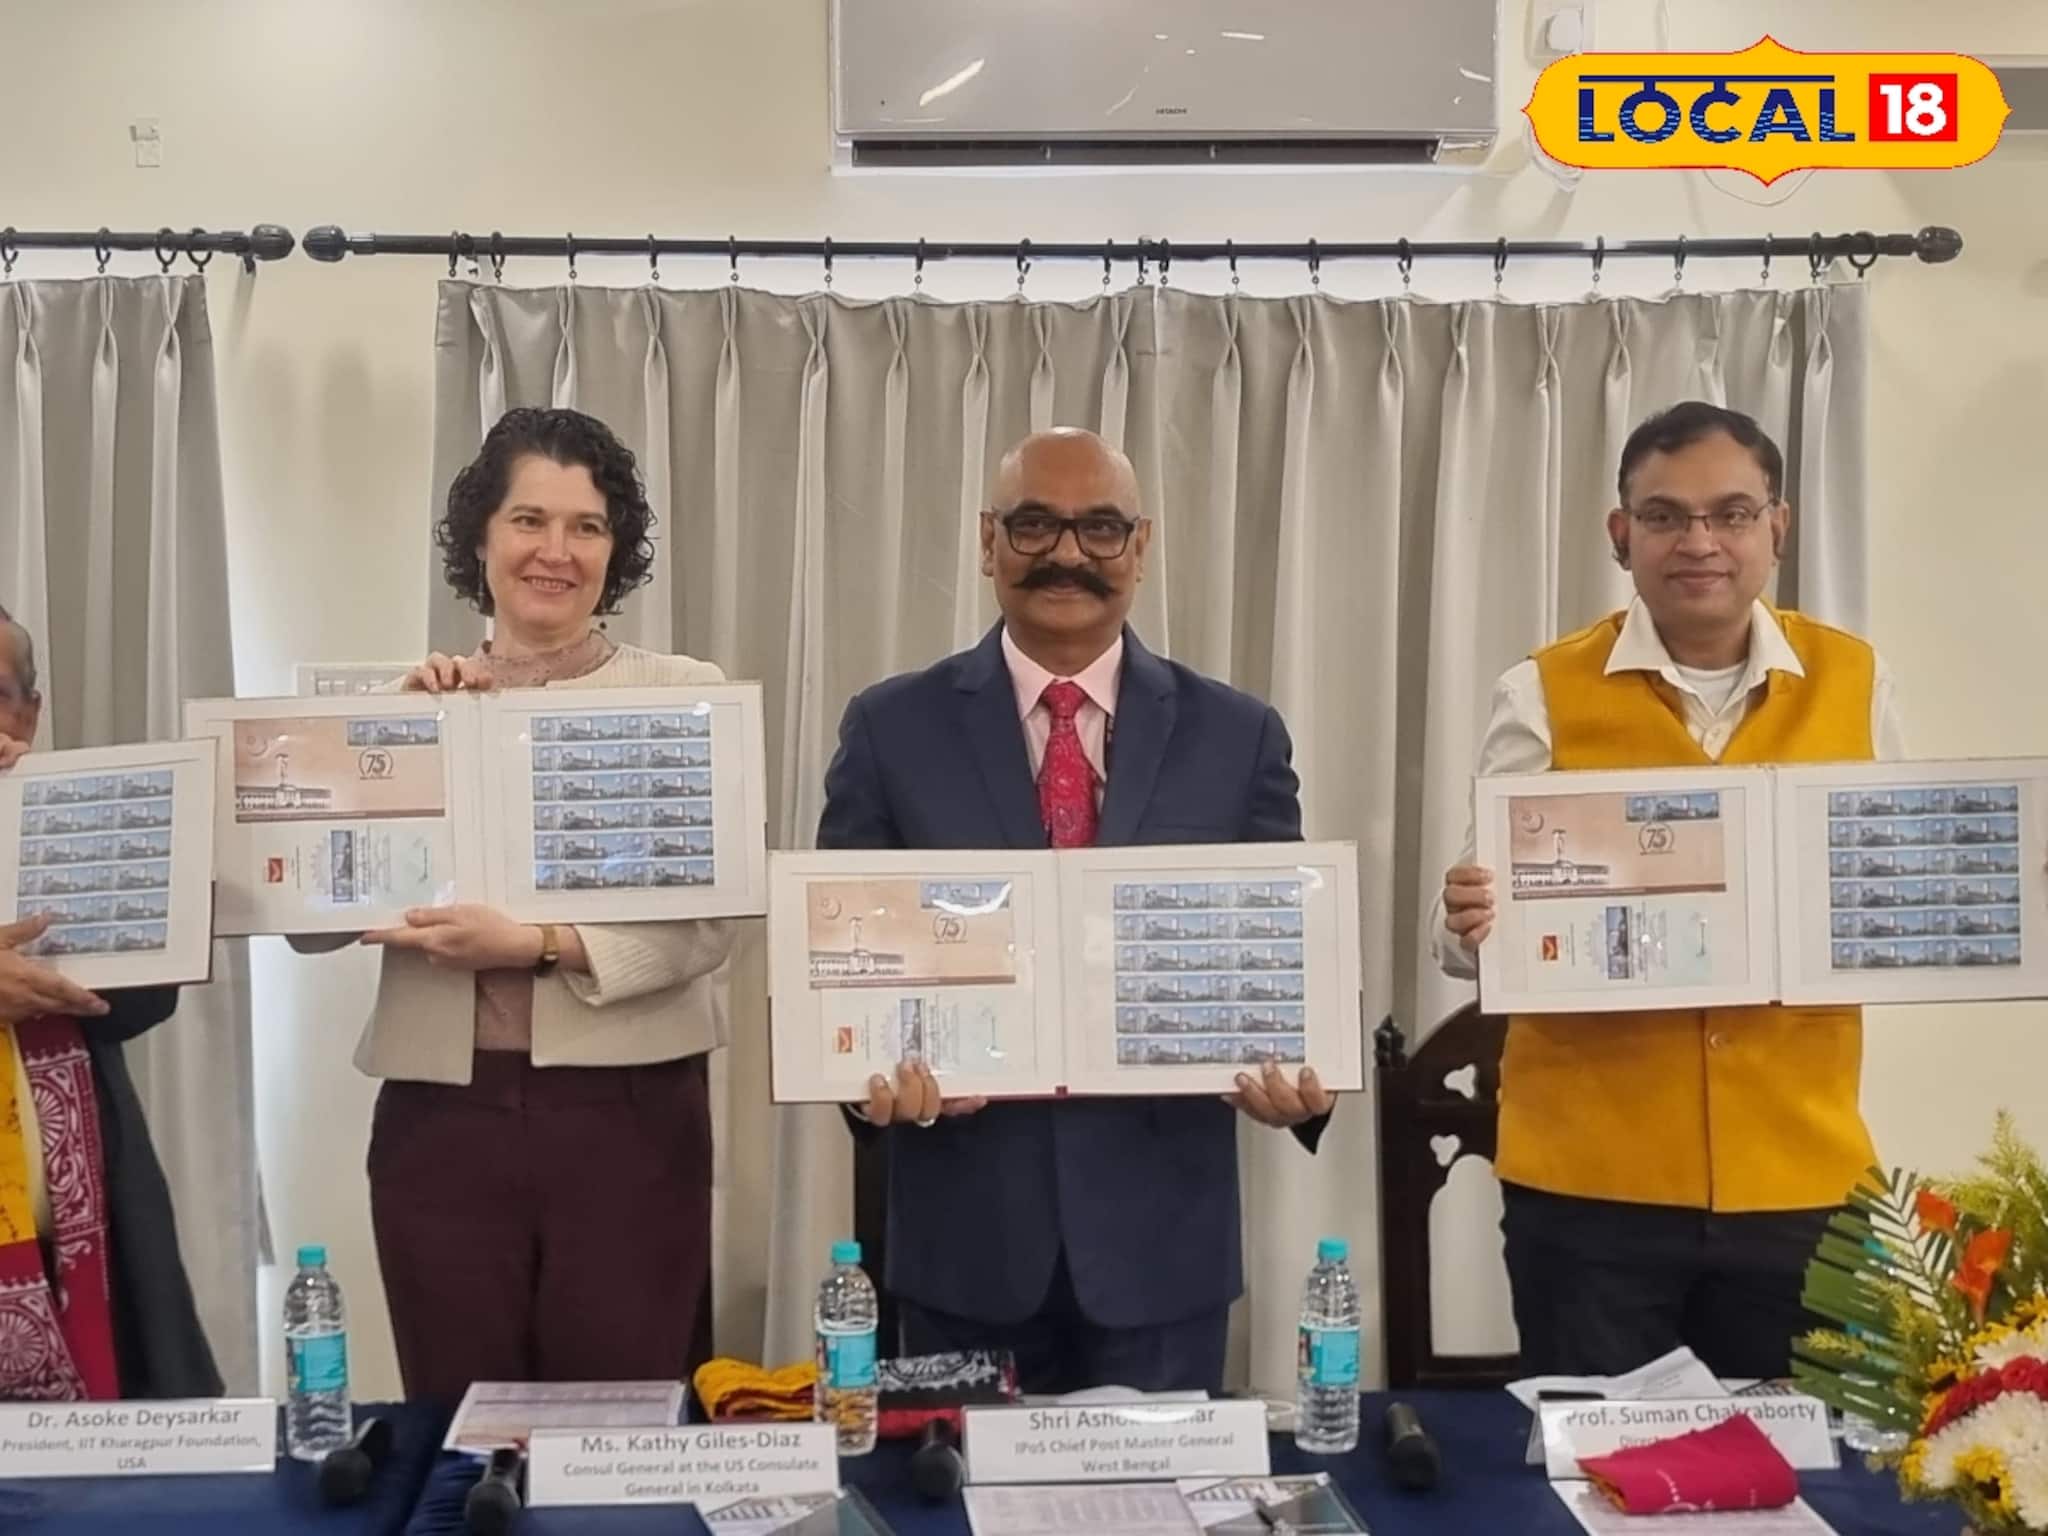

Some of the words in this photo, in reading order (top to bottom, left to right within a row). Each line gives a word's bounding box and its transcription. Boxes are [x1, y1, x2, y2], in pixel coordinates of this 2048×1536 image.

[27, 1411, 58, 1428] Dr.
[65, 1410, 129, 1428] Asoke
[136, 1407, 242, 1430] Deysarkar
[1029, 1412, 1070, 1430] Shri
[1566, 1407, 1615, 1426] Prof.
[1620, 1406, 1689, 1424] Suman
[2, 1438, 75, 1452] President,
[79, 1437, 96, 1450] IIT
[100, 1437, 174, 1452] Kharagpur
[177, 1434, 262, 1449] Foundation,
[580, 1434, 621, 1453] Ms.
[627, 1434, 689, 1454] Kathy
[696, 1430, 802, 1449] Giles-Diaz
[1050, 1438, 1086, 1453] Chief
[1090, 1438, 1120, 1451] Post
[1124, 1436, 1174, 1450] Master
[1178, 1434, 1234, 1448] General
[116, 1456, 147, 1470] USA
[563, 1462, 613, 1477] Consul
[617, 1461, 674, 1475] General
[678, 1462, 693, 1474] at
[696, 1459, 721, 1473] the
[724, 1460, 744, 1472] US
[747, 1457, 820, 1472] Consulate
[1081, 1459, 1119, 1473] West
[1123, 1456, 1171, 1474] Bengal
[625, 1482, 682, 1498] General
[687, 1483, 701, 1496] in
[704, 1480, 760, 1495] Kolkata
